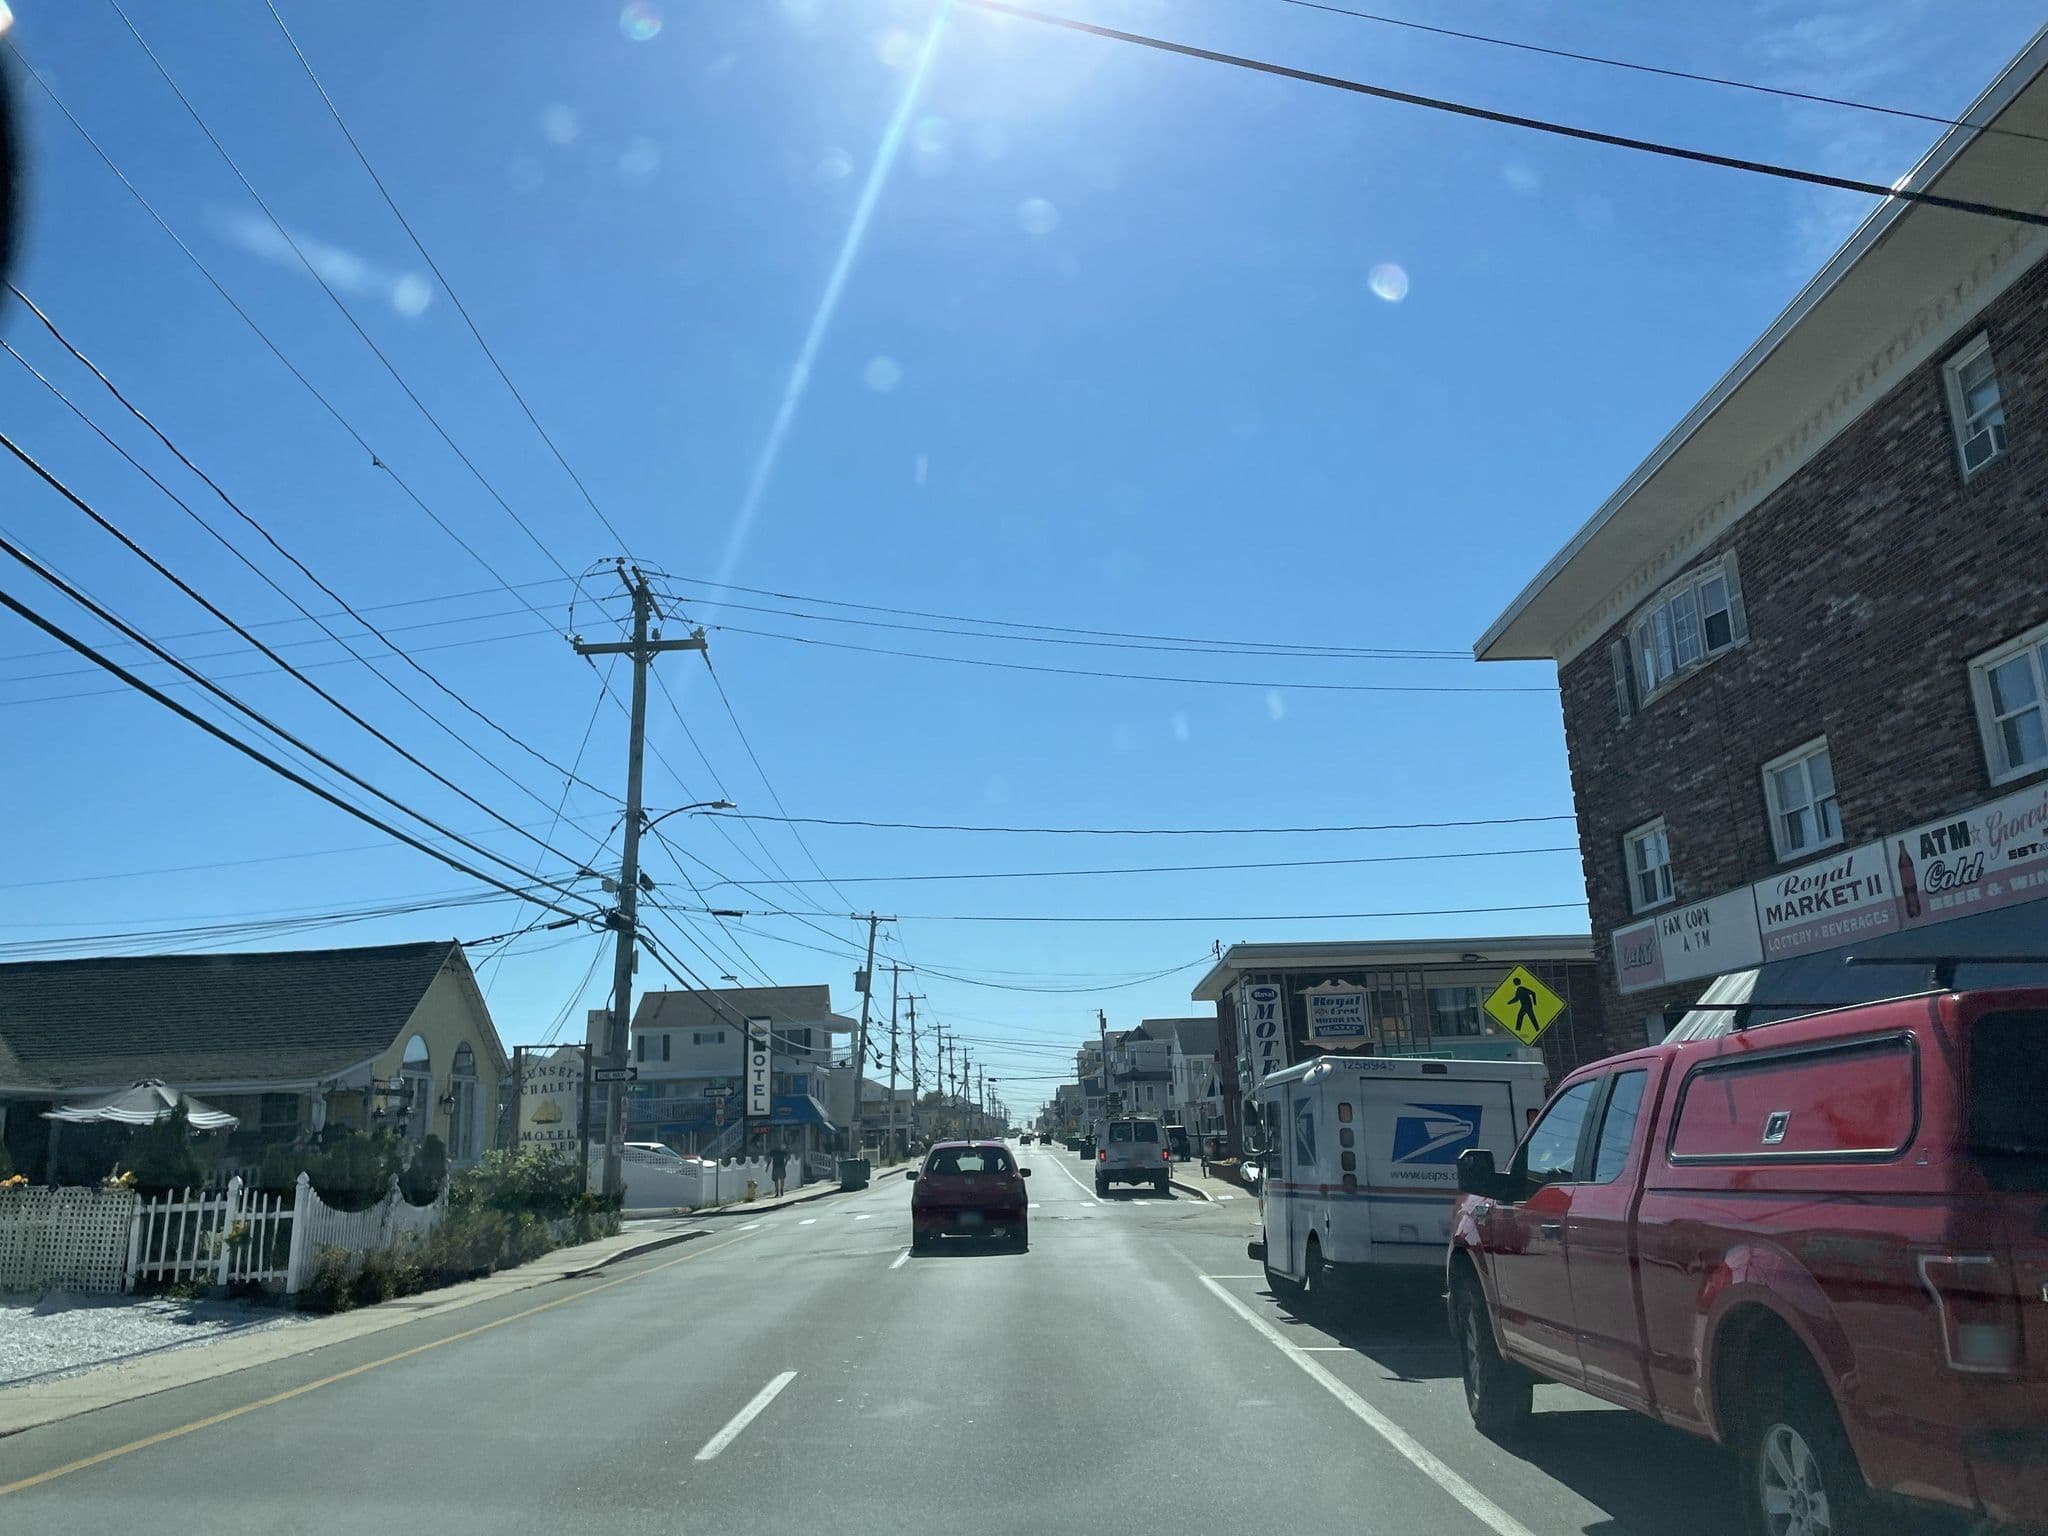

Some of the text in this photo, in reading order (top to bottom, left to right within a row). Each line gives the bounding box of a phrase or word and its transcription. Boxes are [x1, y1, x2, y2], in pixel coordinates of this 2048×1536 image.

[1920, 820, 1971, 860] ATM
[2007, 842, 2039, 860] EBT
[1777, 856, 1854, 897] Royal
[1924, 851, 1985, 894] Cold
[1765, 880, 1863, 926] MARKET
[1662, 907, 1711, 936] FAX COPY
[1821, 909, 1889, 937] BEVERAGES
[1312, 995, 1361, 1009] Royal
[1330, 1007, 1360, 1015] Crest
[520, 1065, 575, 1084] SUNSET
[520, 1081, 575, 1096] CHALET
[521, 1129, 576, 1142] MOTEL
